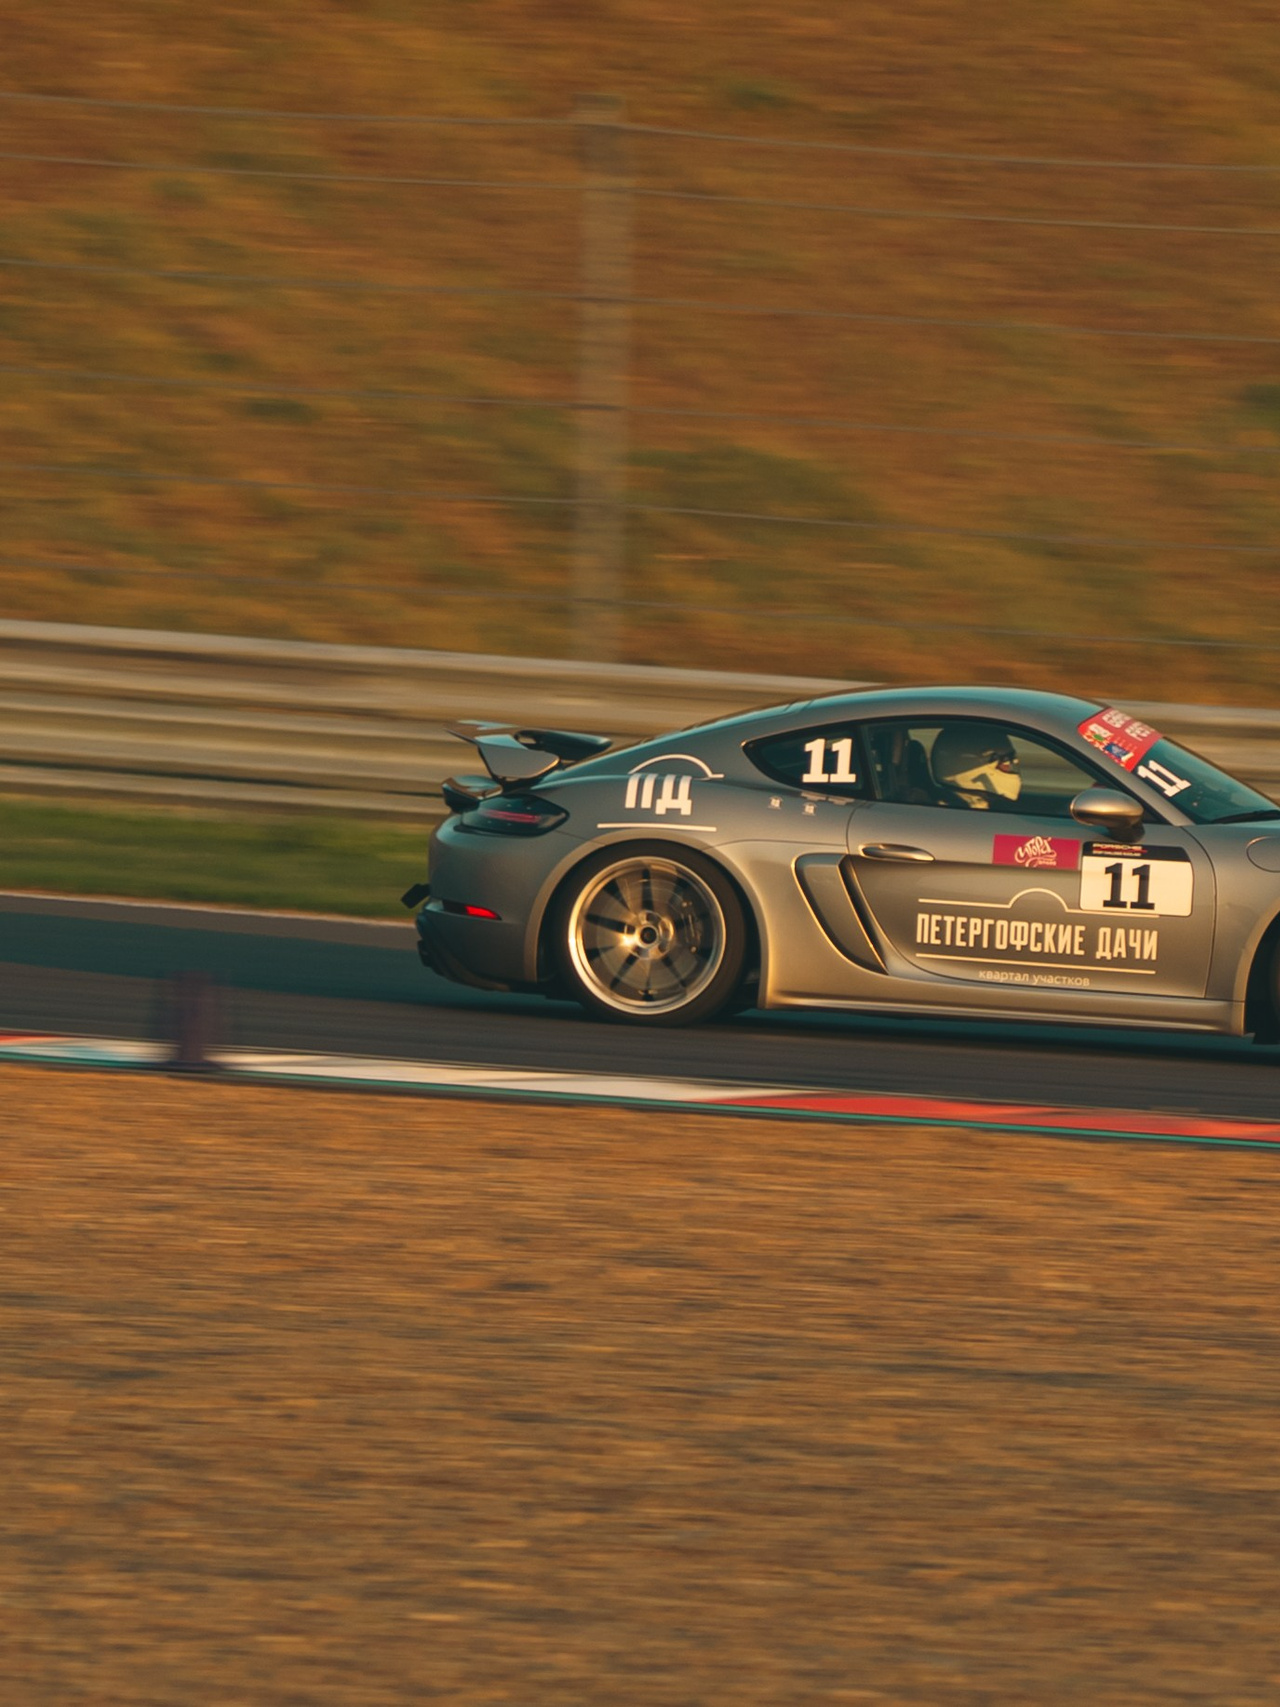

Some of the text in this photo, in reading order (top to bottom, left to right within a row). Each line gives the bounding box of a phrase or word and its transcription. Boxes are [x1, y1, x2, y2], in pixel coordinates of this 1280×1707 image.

[802, 738, 857, 783] 11
[1137, 759, 1192, 798] 11
[1102, 862, 1156, 911] 11
[916, 913, 1159, 961] ПЕТЕРГОФСКИЕ ДАЧИ
[978, 970, 1091, 987] квартал участков
